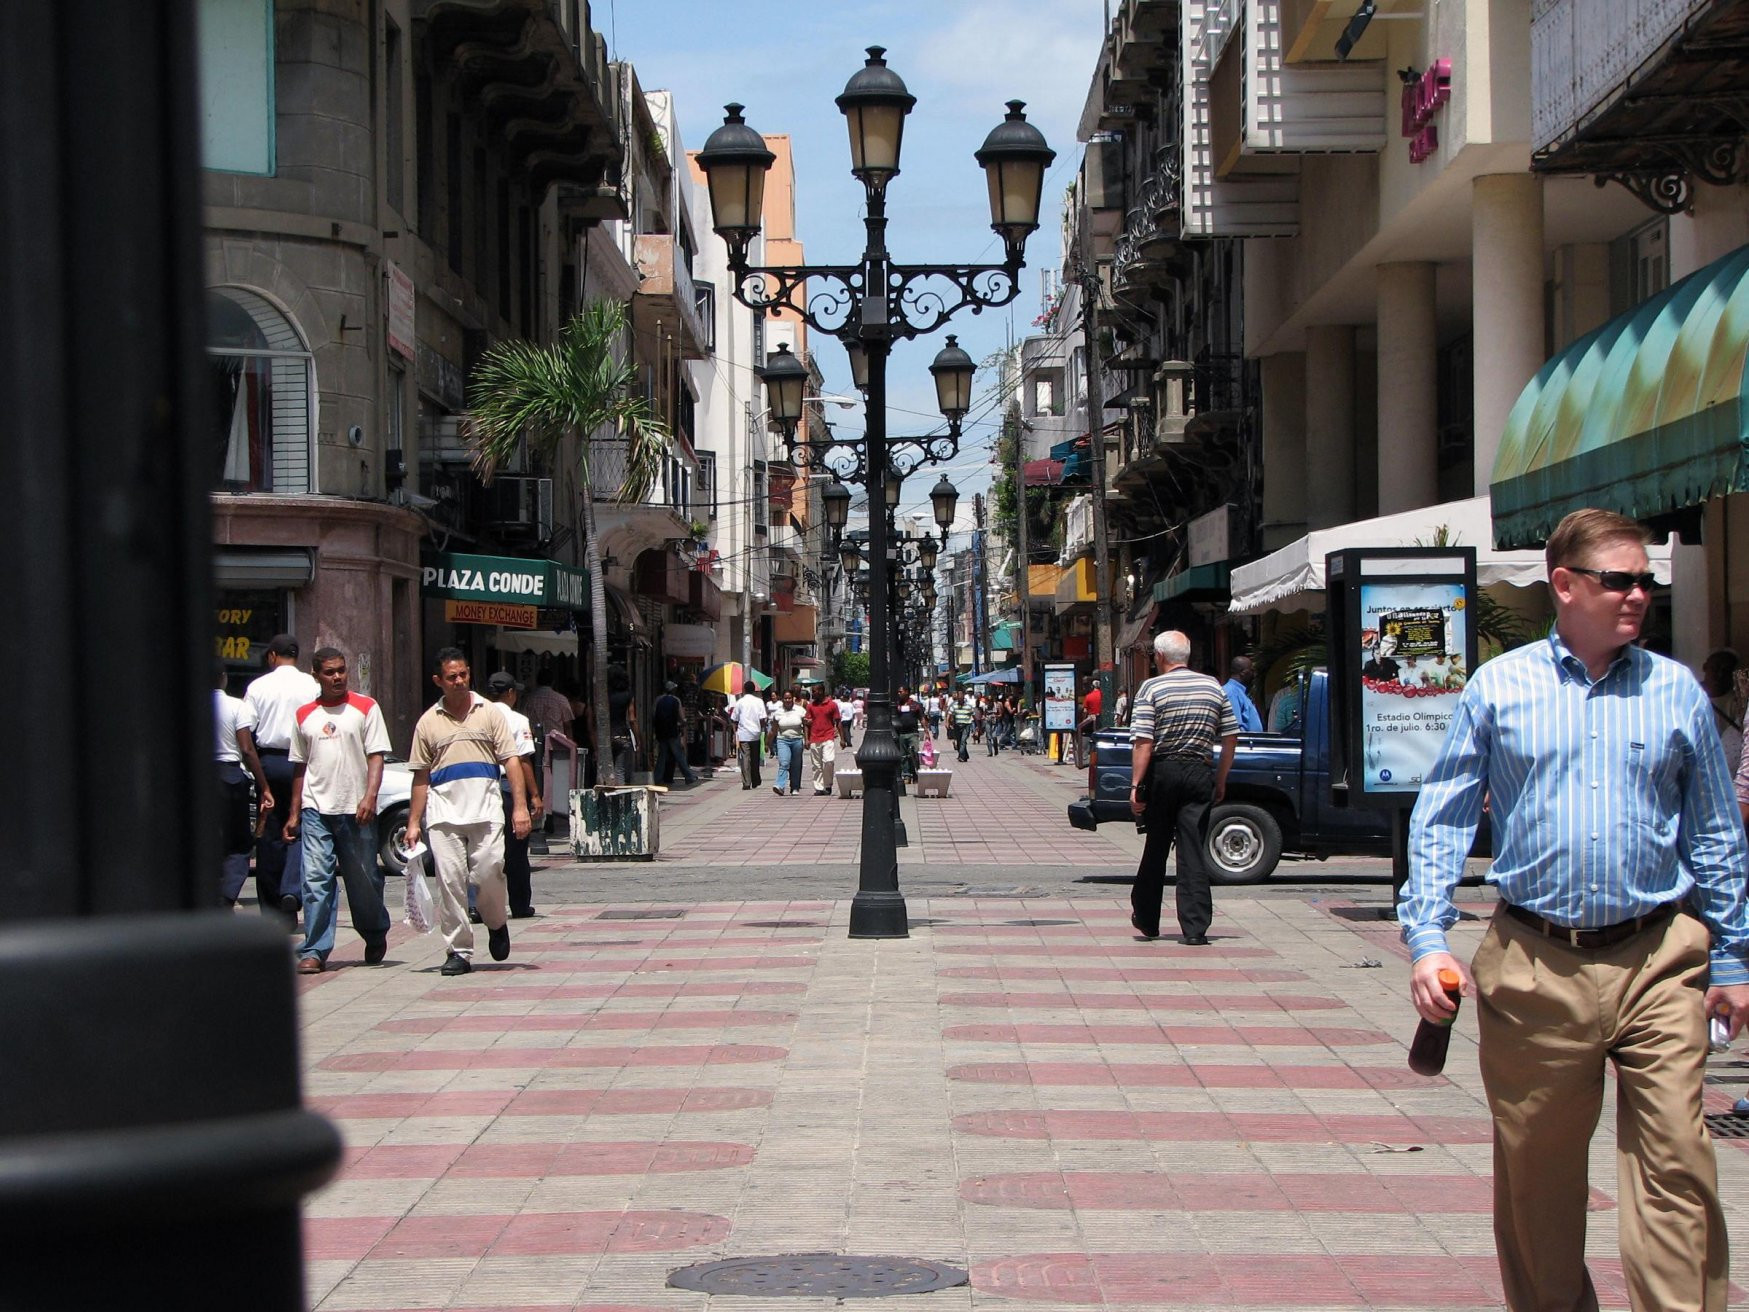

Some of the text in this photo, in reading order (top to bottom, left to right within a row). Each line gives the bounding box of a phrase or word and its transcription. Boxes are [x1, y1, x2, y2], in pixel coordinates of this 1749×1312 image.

[423, 566, 544, 596] PLAZA CONDE
[218, 609, 252, 625] ORY
[455, 604, 534, 624] MONEY EXCHANGE
[1377, 713, 1411, 722] Estadio
[1366, 724, 1384, 733] 1ro.
[1386, 723, 1399, 732] de
[1425, 722, 1446, 732] 6:30
